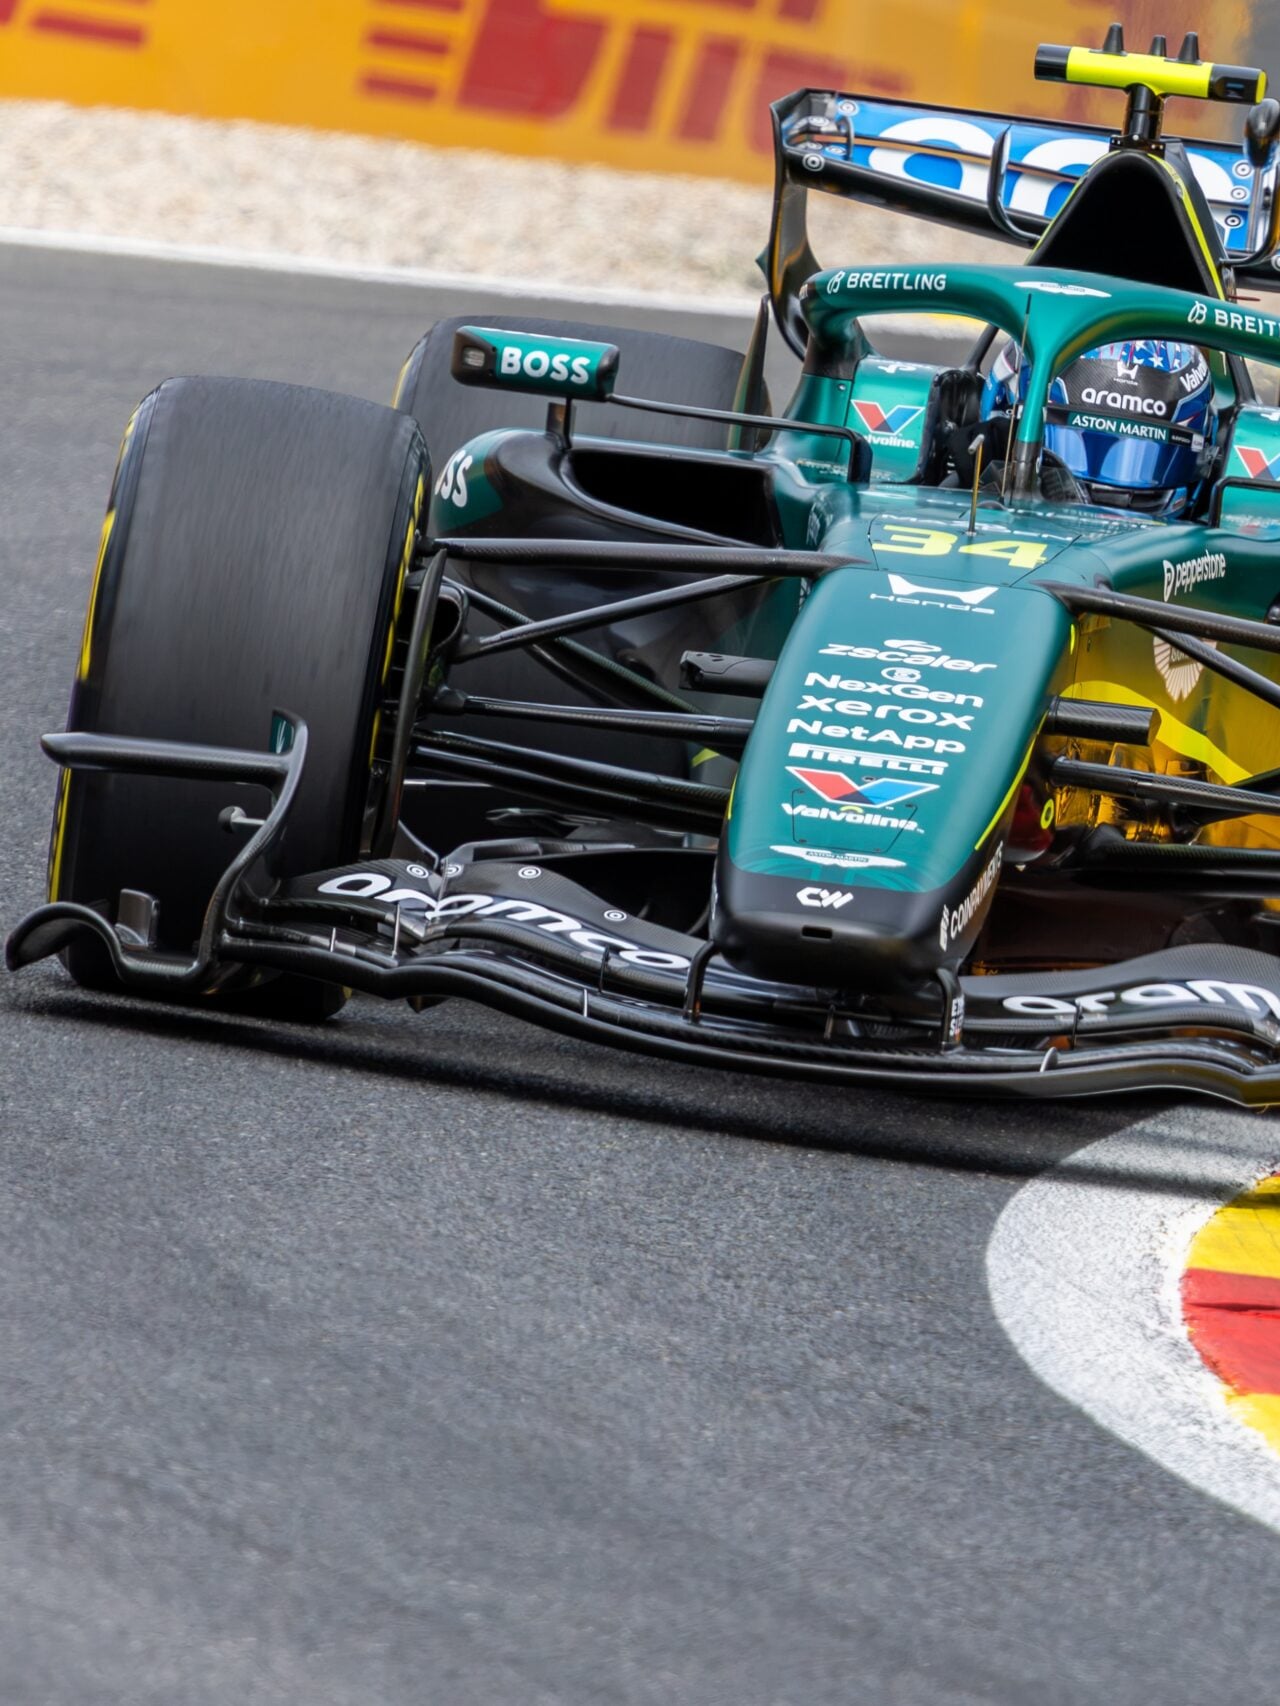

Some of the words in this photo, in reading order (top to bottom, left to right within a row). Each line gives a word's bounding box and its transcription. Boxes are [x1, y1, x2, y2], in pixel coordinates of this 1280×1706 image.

[847, 272, 946, 292] BREITLING
[501, 347, 590, 384] BOSS
[1081, 387, 1166, 416] aramco
[1072, 414, 1117, 434] ASTON
[1119, 423, 1166, 440] MARTIN
[871, 524, 1047, 569] 34
[1174, 550, 1226, 595] pepperstone
[818, 643, 997, 673] zscaler
[804, 672, 984, 708] NexGen
[796, 695, 975, 731] xerox
[786, 718, 966, 753] NetApp
[788, 742, 949, 775] PIRELLI
[781, 803, 918, 831] Valvoline
[318, 872, 691, 969] aramco
